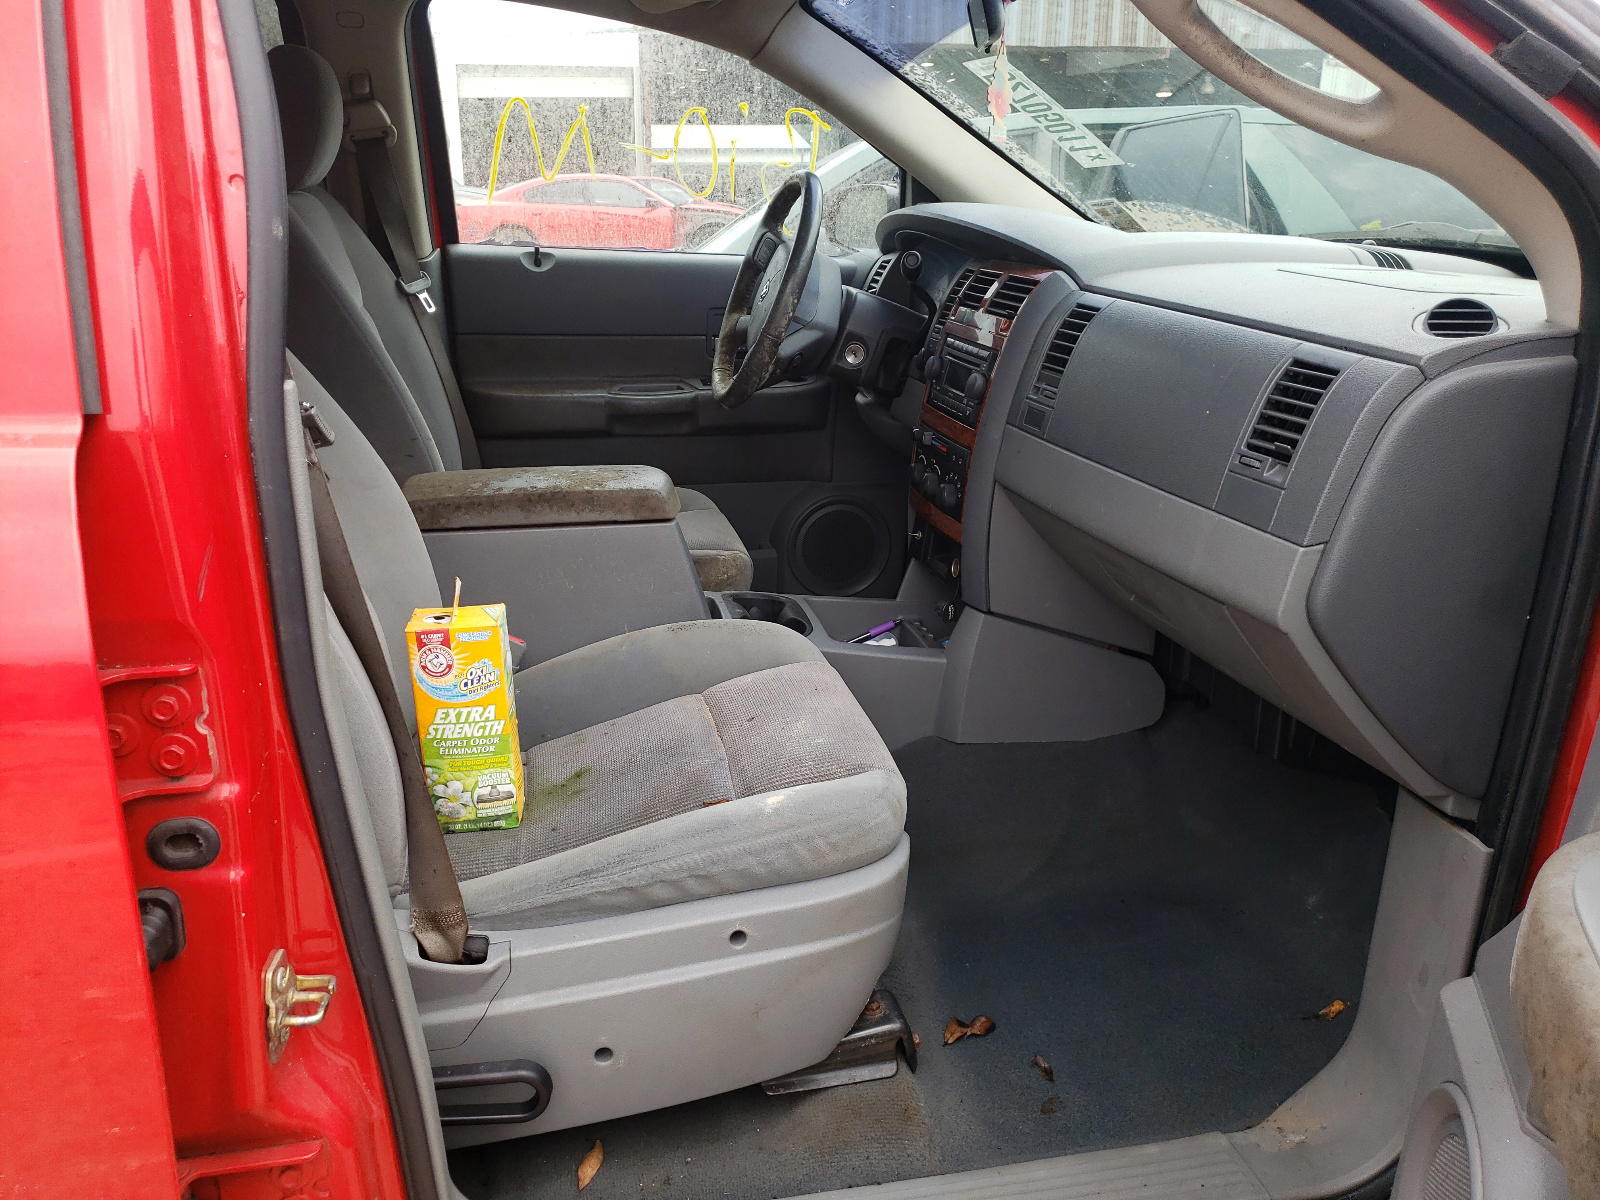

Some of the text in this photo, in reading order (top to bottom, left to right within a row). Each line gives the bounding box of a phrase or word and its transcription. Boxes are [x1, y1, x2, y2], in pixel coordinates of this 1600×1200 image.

[466, 665, 487, 678] OXI
[461, 672, 496, 691] CLEAN
[433, 704, 497, 724] EXTRA
[426, 720, 506, 739] STRENGTH
[433, 736, 500, 748] CARPET ODOR
[439, 745, 496, 755] ELIMINATOR
[478, 771, 510, 782] VACUUM
[478, 778, 511, 788] BOOSTER
